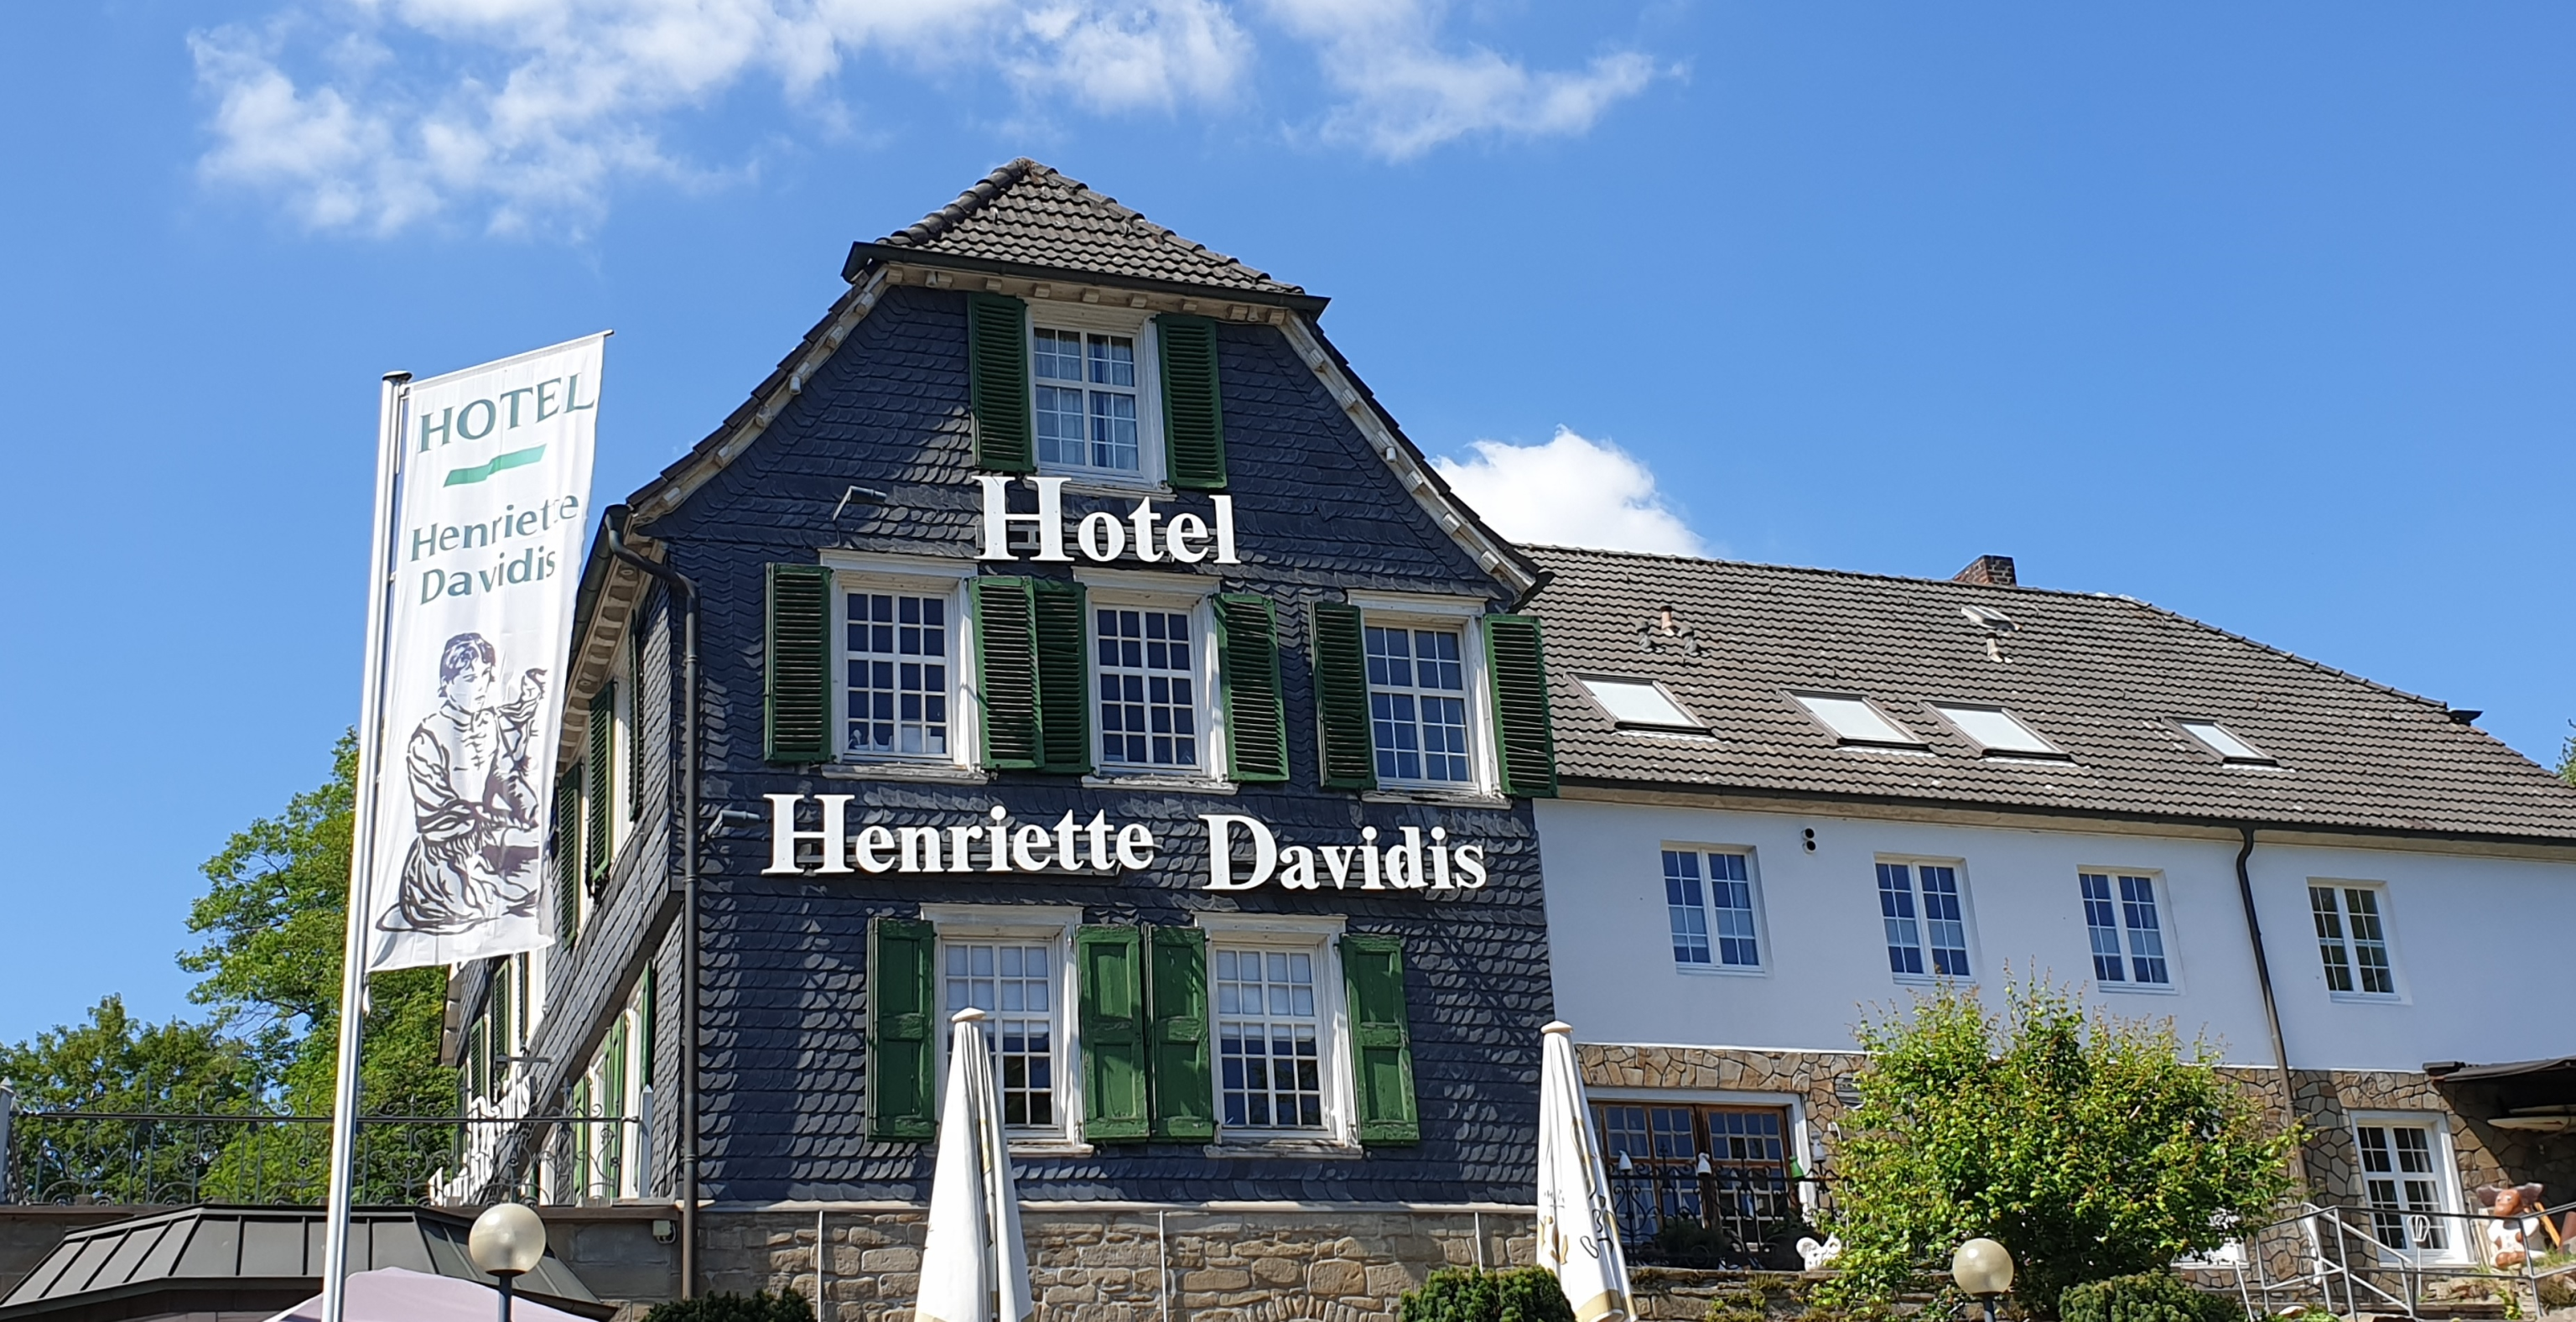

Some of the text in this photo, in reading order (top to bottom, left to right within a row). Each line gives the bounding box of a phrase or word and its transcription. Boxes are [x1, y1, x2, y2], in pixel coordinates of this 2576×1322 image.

[419, 372, 595, 453] HOTEL
[410, 495, 579, 562] Henriete
[974, 476, 1241, 565] Hotel
[420, 545, 556, 605] Davidis
[762, 794, 1488, 891] Henriette Davidis
